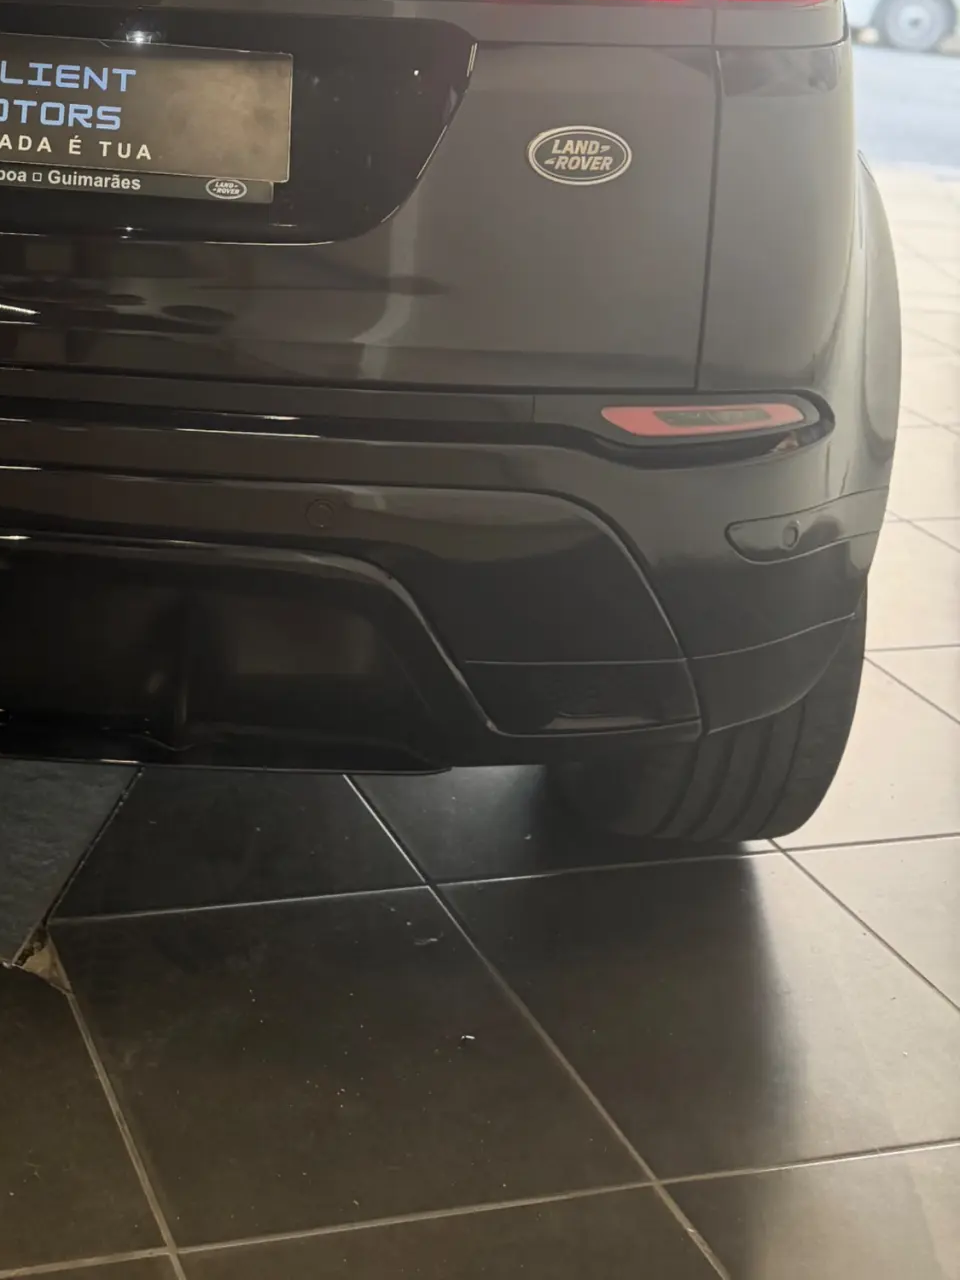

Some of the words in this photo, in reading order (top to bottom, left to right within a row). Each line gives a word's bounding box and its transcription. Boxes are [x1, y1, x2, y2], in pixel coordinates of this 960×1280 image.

[68, 135, 82, 155] É
[98, 140, 152, 161] TUA
[551, 139, 600, 155] LAND
[554, 155, 614, 171] ROVER
[47, 169, 141, 190] Guimarães
